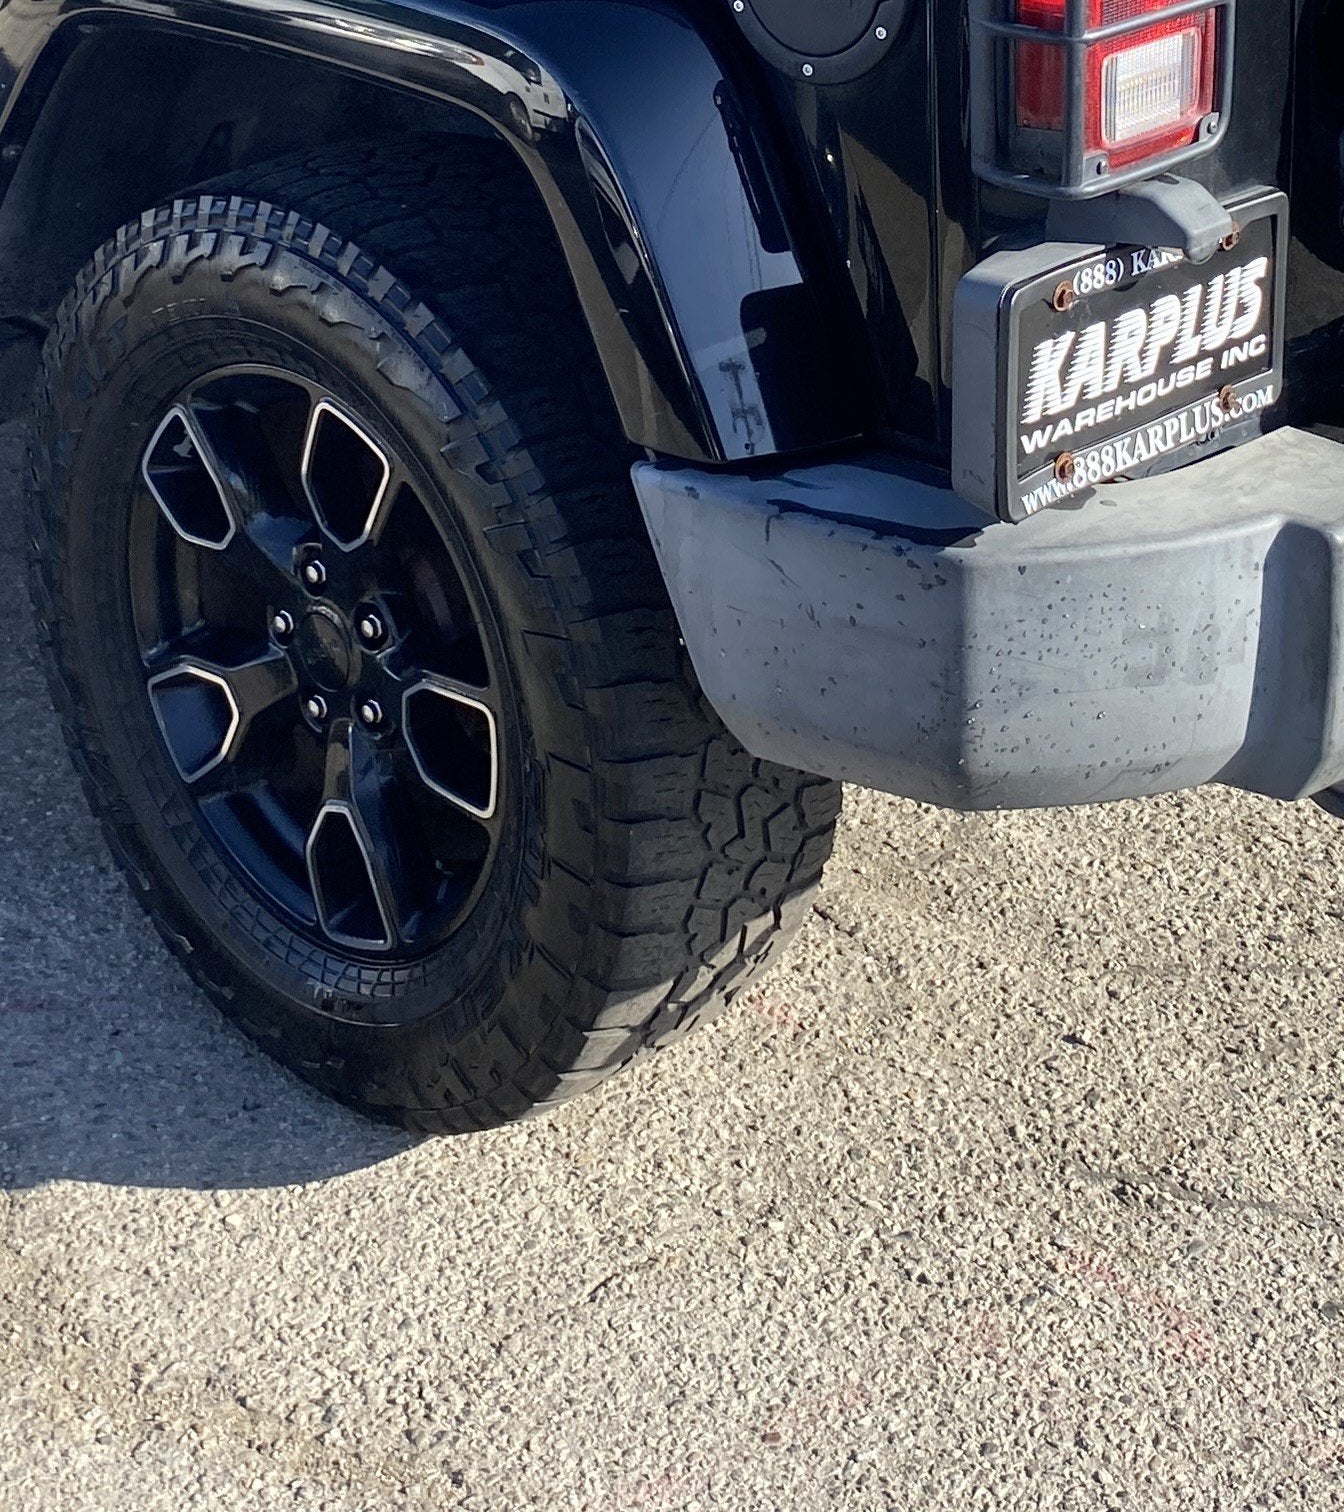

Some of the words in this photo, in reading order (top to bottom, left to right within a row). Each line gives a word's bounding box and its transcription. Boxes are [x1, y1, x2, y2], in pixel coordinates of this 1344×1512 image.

[1073, 257, 1125, 296] (888)
[1020, 357, 1215, 454] WAREHOUSE
[1220, 333, 1267, 370] INC
[1021, 256, 1268, 424] KARPLUS
